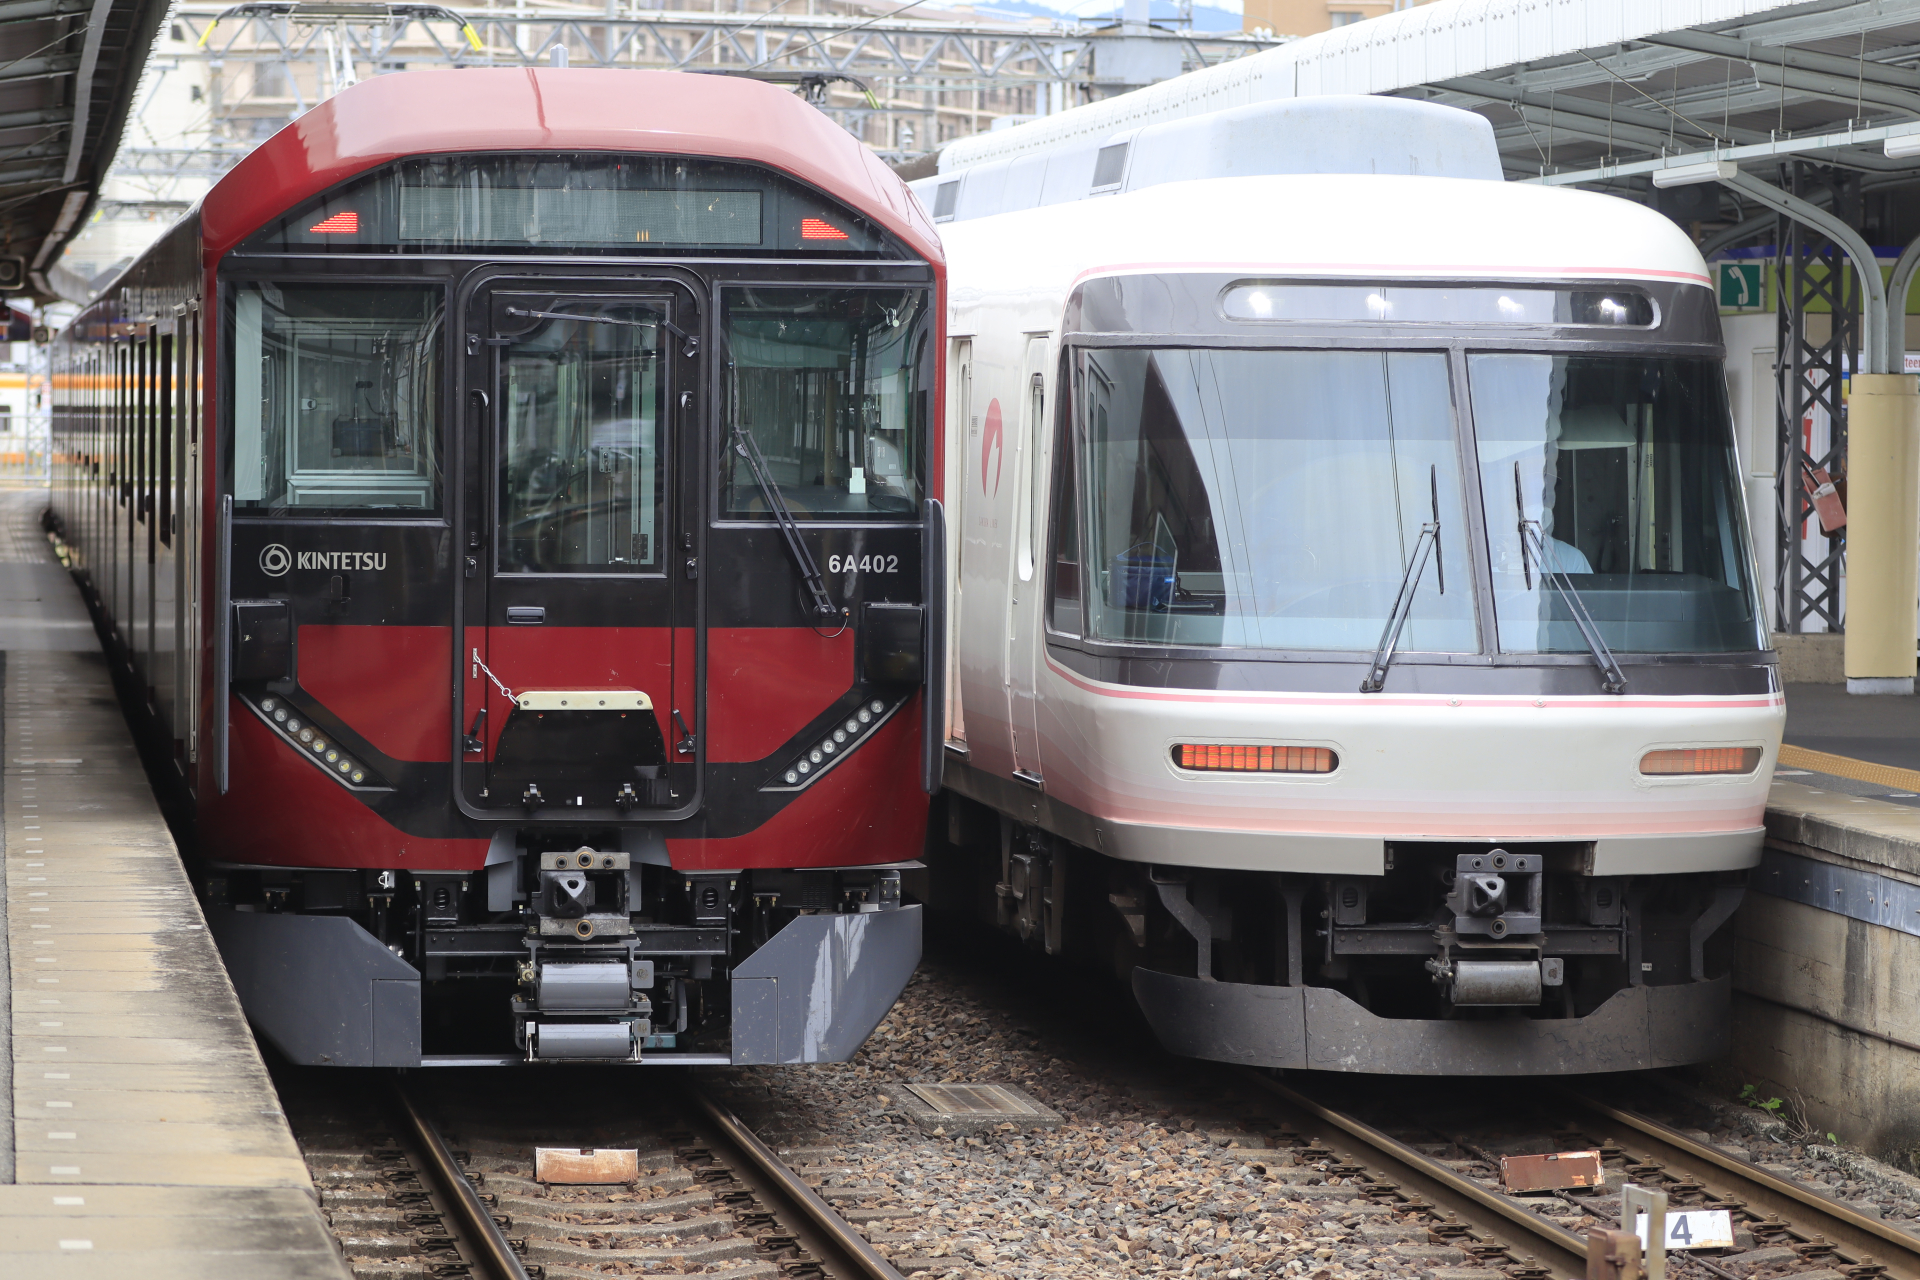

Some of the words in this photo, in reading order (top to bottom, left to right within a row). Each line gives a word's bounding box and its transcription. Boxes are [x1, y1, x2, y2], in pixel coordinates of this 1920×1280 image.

[297, 551, 387, 571] KINTETSU
[828, 554, 899, 574] 6A402
[1670, 1214, 1693, 1245] 4
